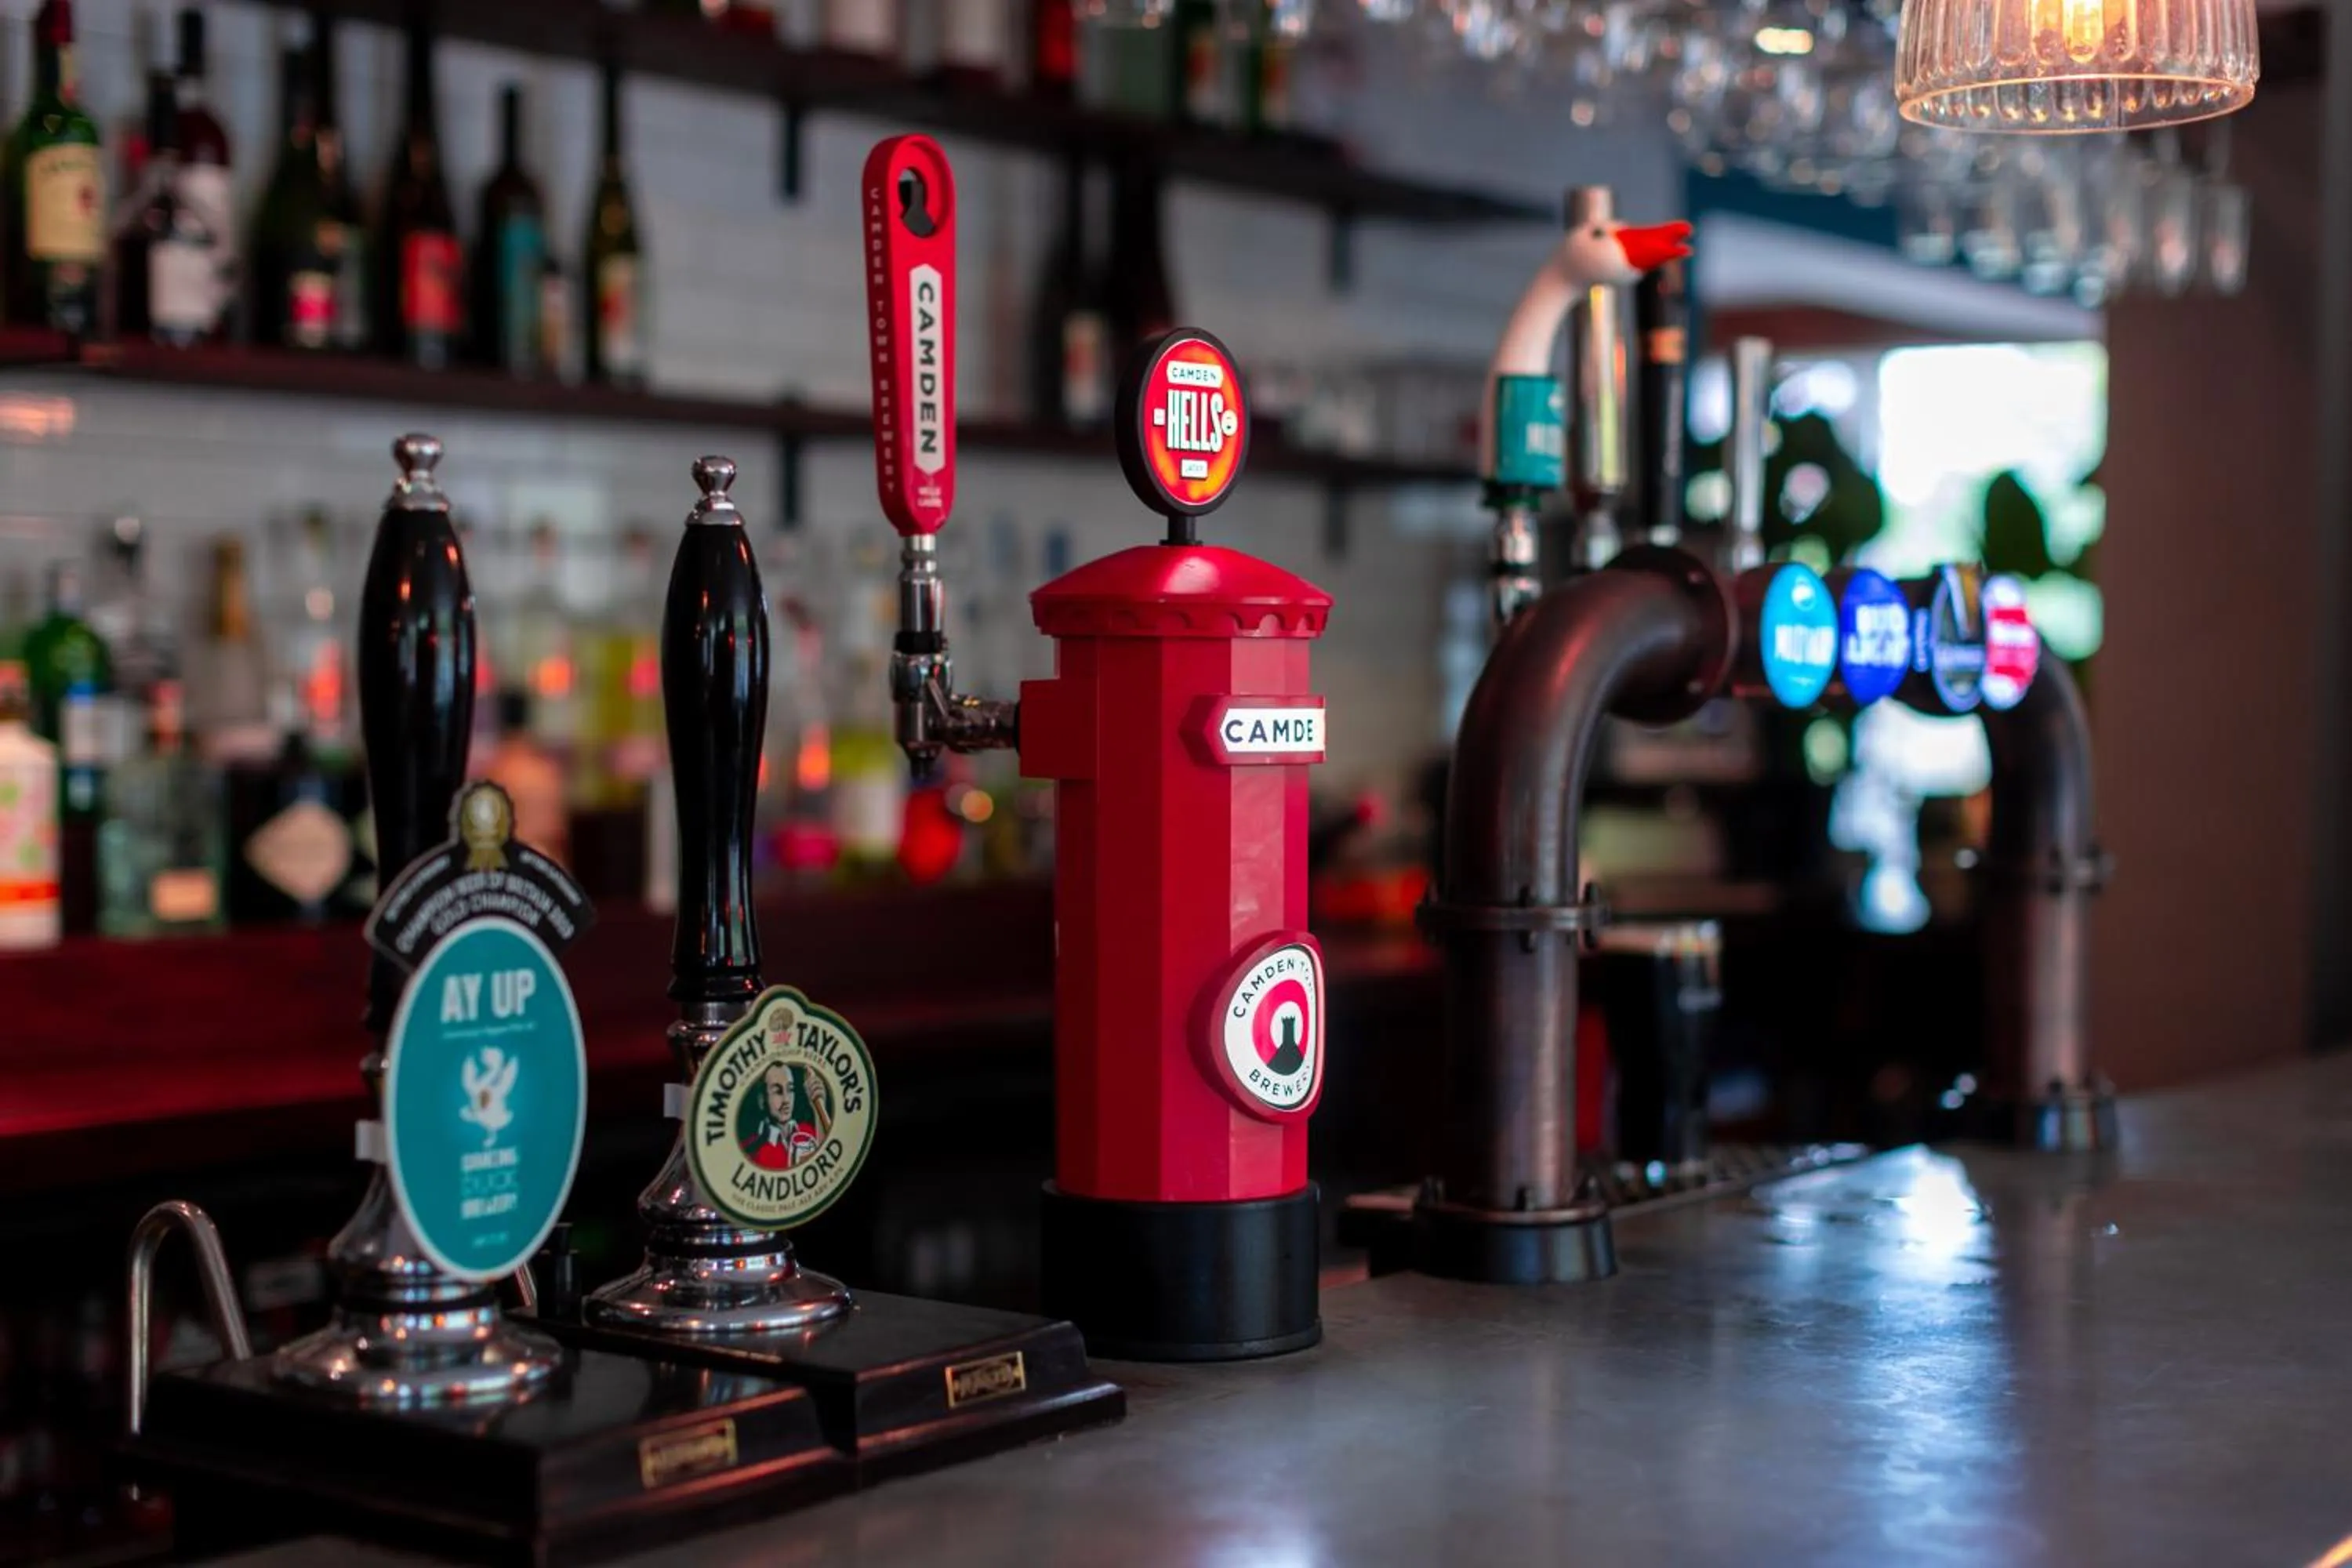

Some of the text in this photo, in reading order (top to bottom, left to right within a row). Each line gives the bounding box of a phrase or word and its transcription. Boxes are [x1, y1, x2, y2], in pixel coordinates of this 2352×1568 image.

[869, 187, 884, 285] CAMDEN
[917, 281, 938, 455] CAMDEN
[1172, 366, 1217, 382] CAMDEN
[1167, 390, 1223, 452] HELLS
[441, 968, 535, 1023] AY UP
[1233, 959, 1294, 1018] CAMDEN
[706, 1022, 862, 1146] TIMOTHY TAYLOR'S
[1249, 1065, 1310, 1096] BREWE
[731, 1138, 844, 1201] LANDLORD
